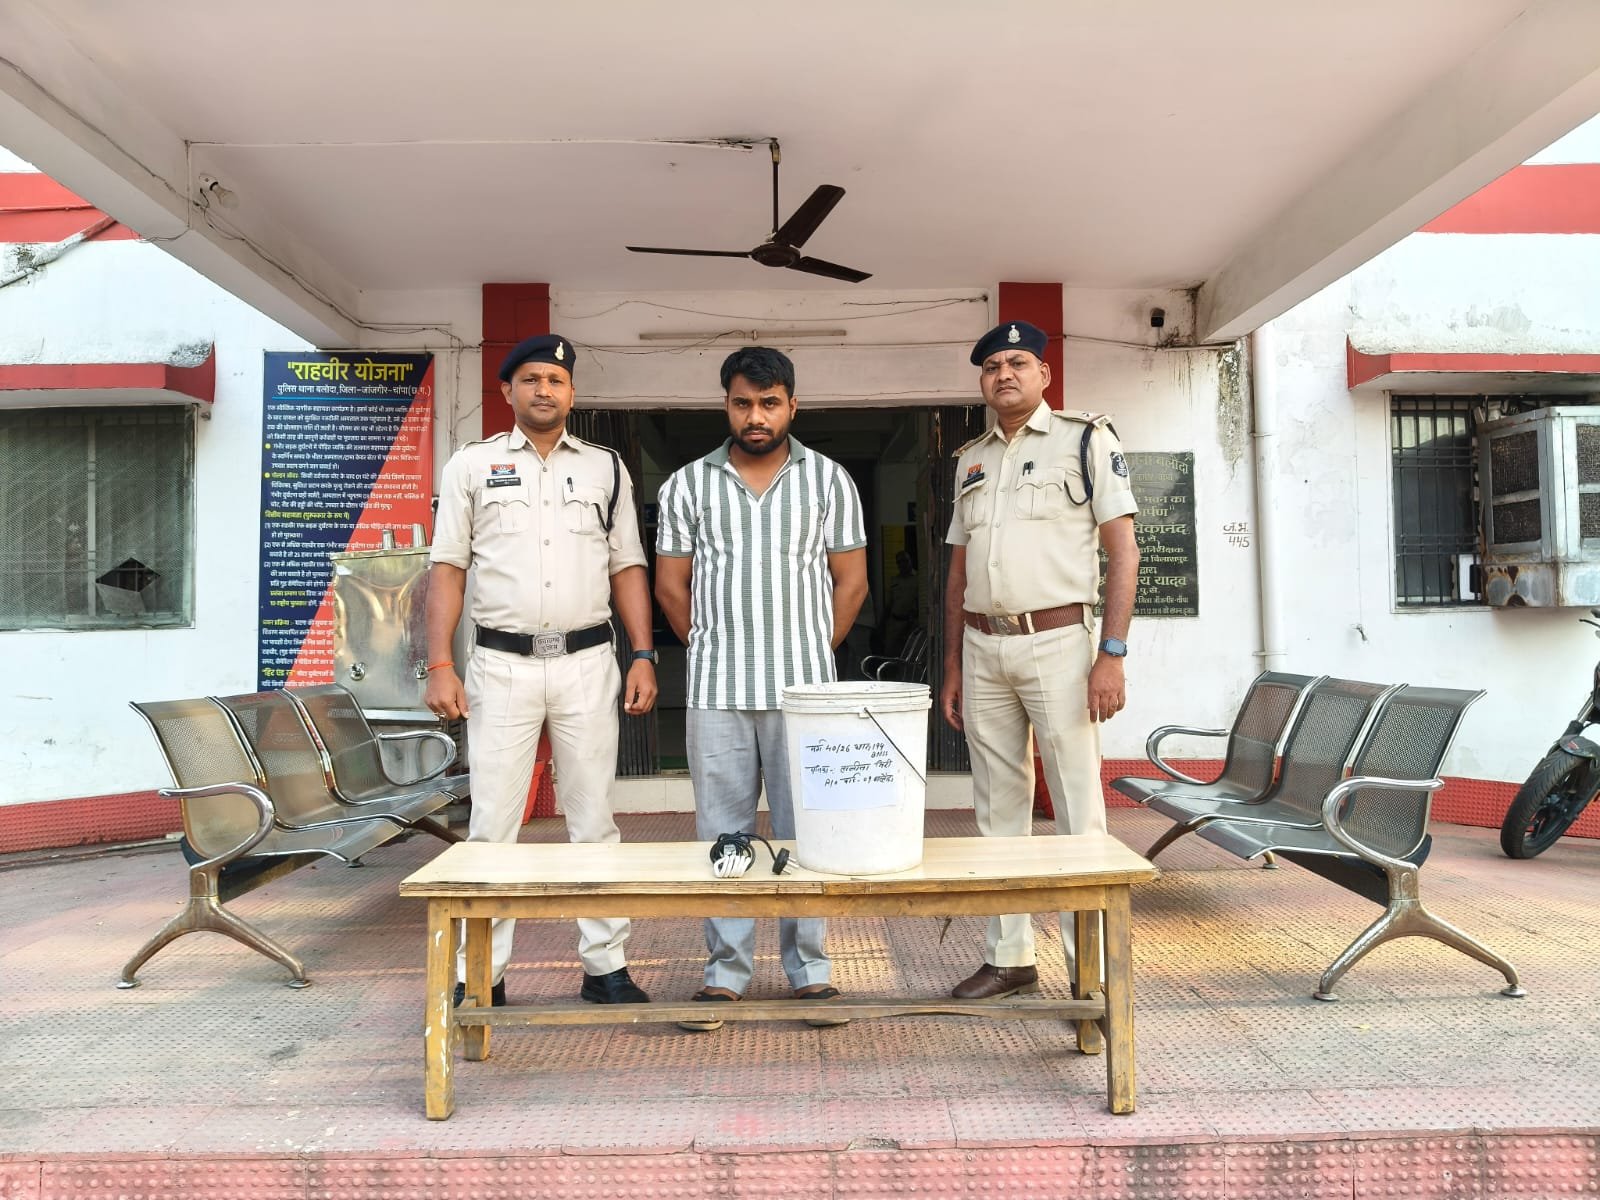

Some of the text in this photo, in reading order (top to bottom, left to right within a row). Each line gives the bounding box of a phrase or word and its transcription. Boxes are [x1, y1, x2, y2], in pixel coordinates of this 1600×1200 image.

[287, 357, 414, 382] "राहवीर योजना"
[277, 383, 297, 395] पुलिस
[1170, 495, 1186, 504] का
[1154, 576, 1187, 587] यादव
